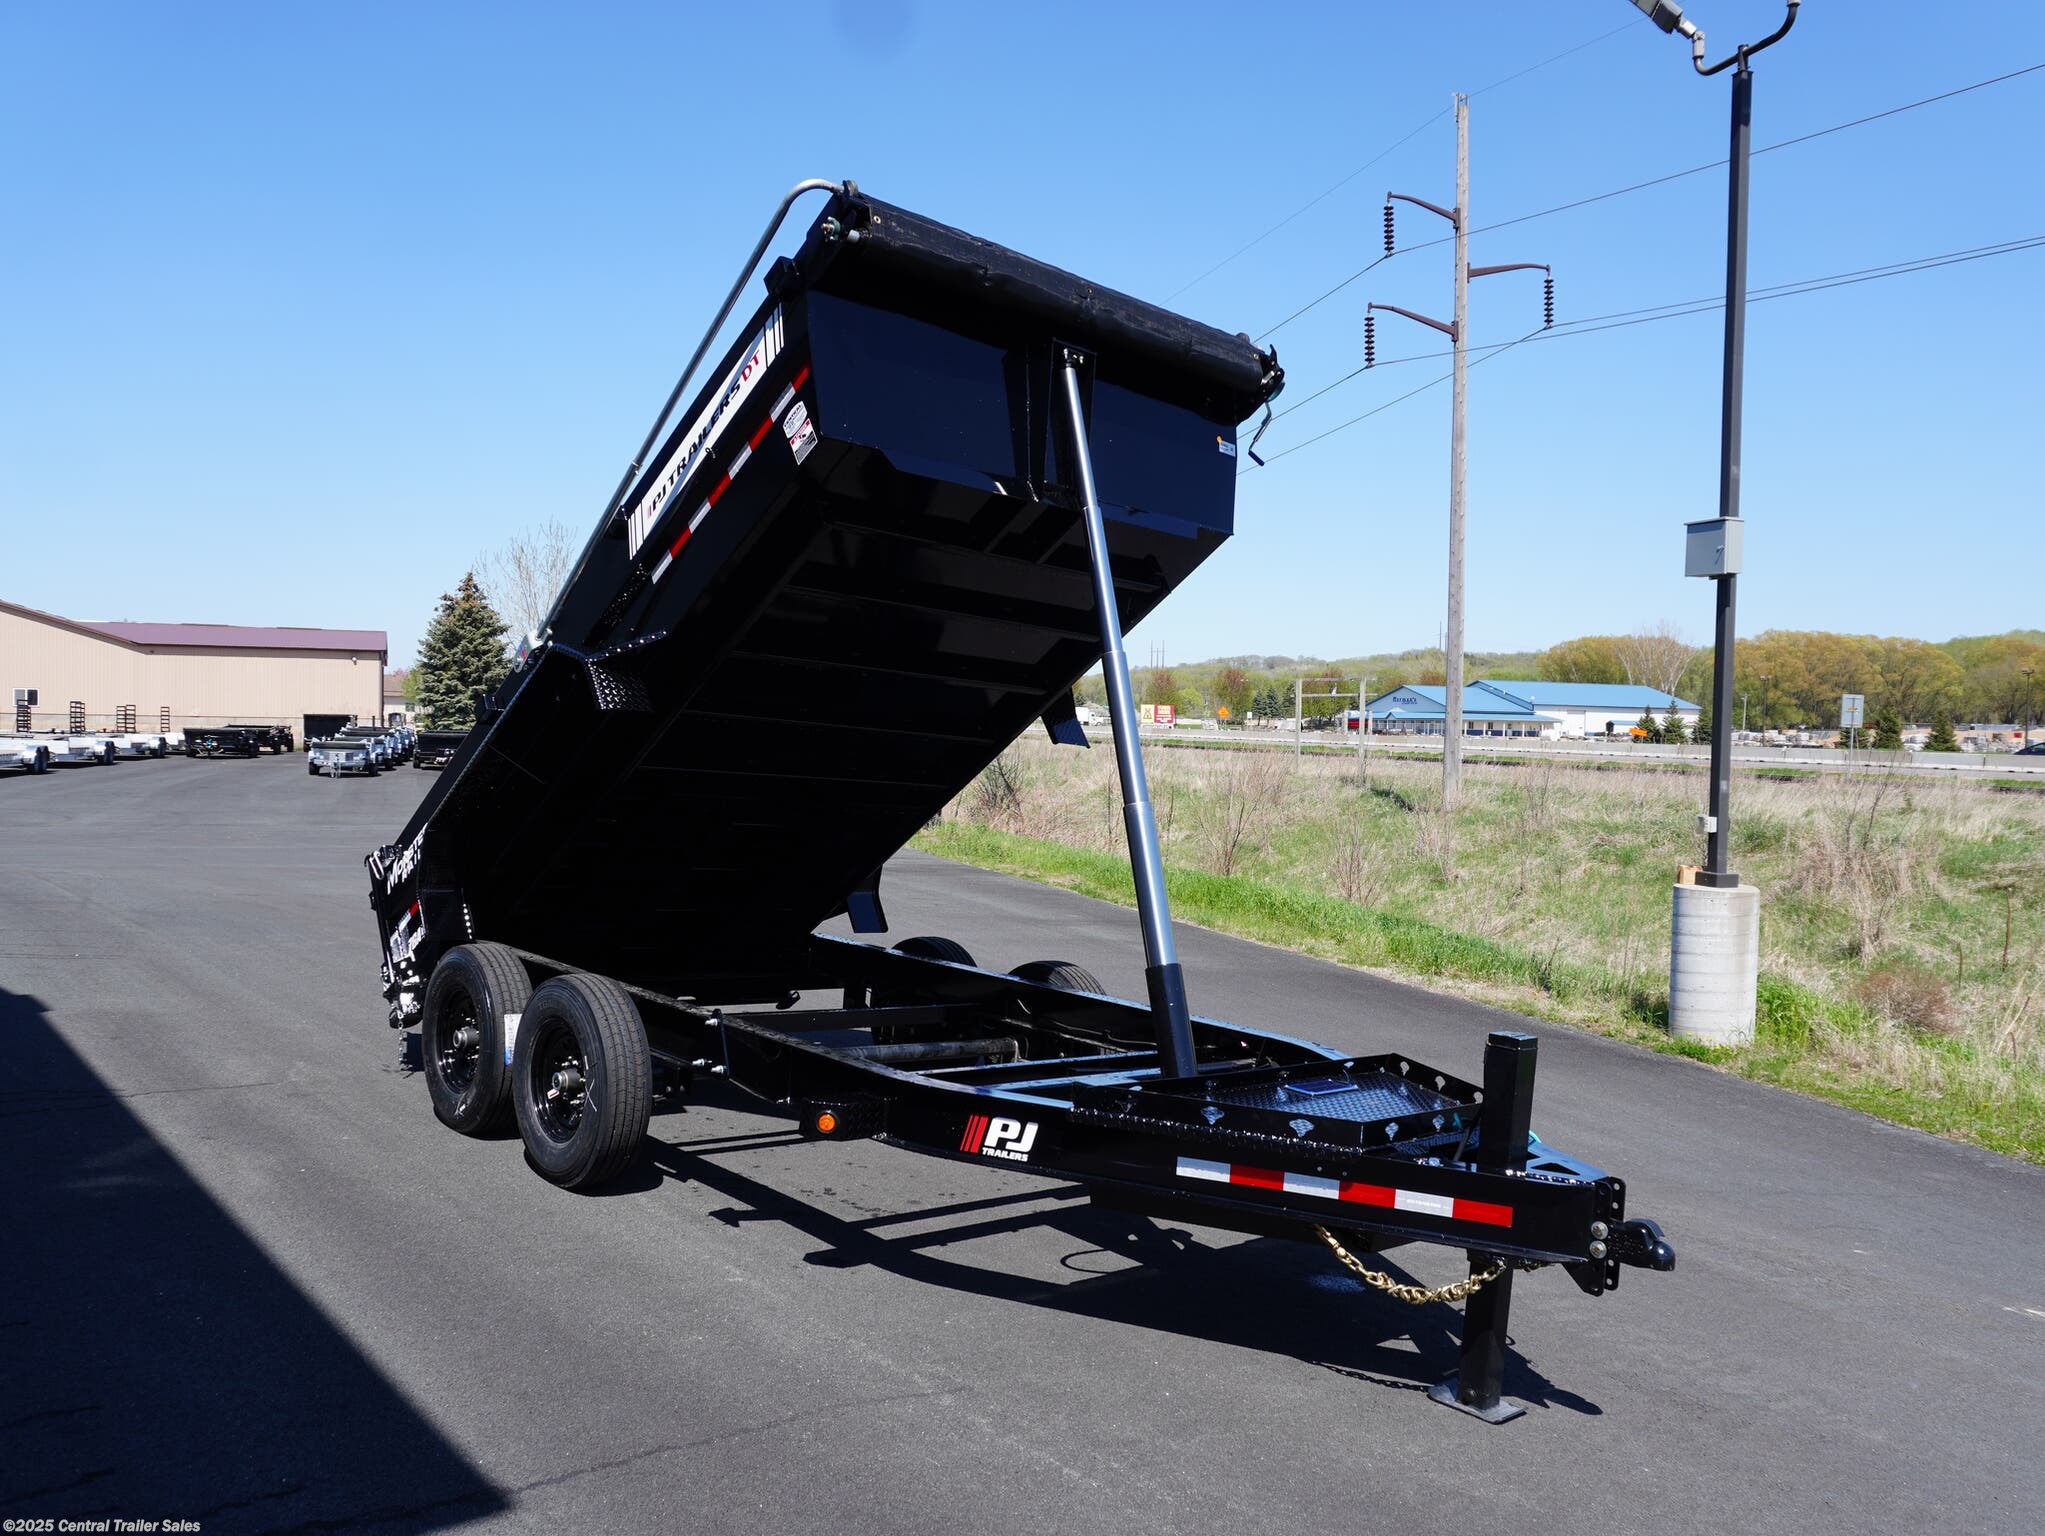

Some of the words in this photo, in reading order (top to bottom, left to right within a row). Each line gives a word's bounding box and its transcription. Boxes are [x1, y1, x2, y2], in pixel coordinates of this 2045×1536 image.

[652, 483, 667, 511] PJ
[667, 379, 741, 486] TRAILERS
[741, 349, 760, 382] DT
[984, 1116, 1039, 1152] PJ
[982, 1146, 1029, 1162] TRAILERS
